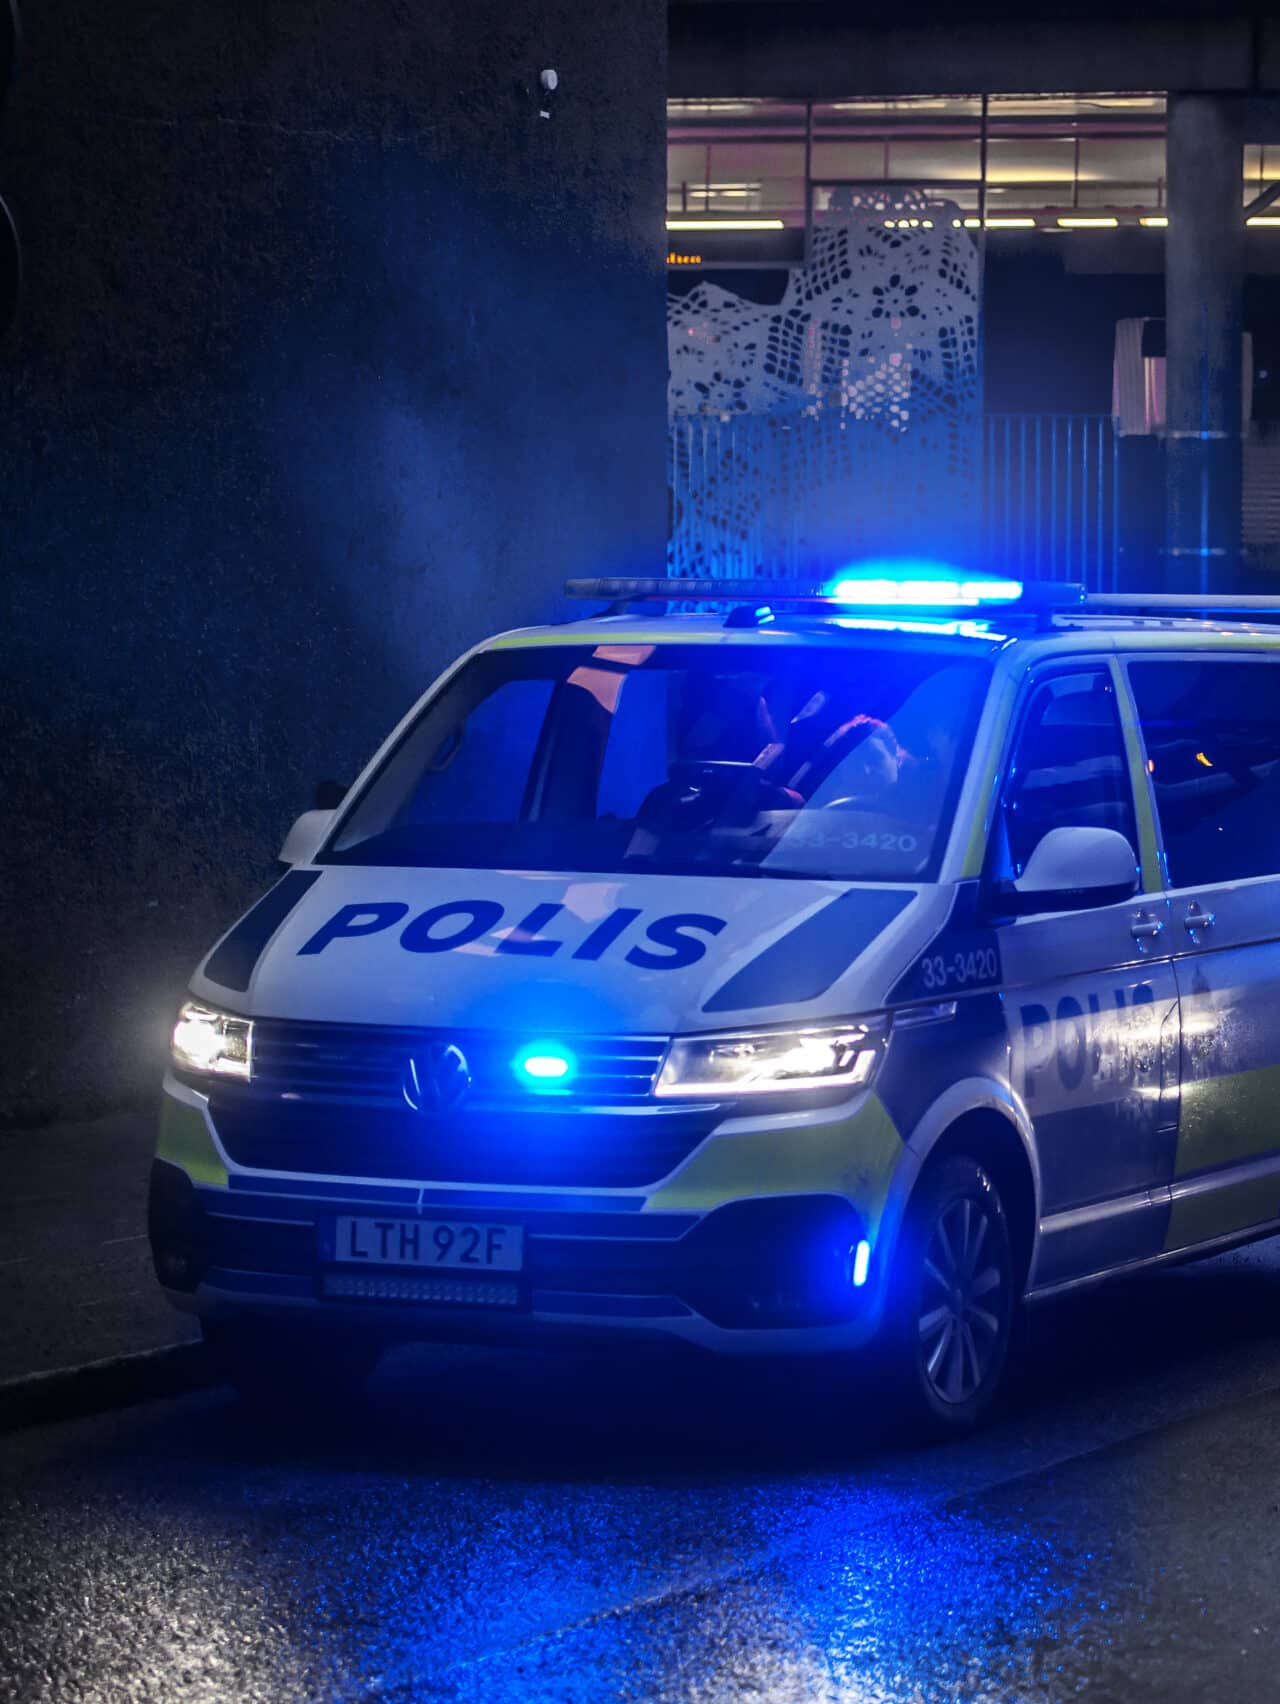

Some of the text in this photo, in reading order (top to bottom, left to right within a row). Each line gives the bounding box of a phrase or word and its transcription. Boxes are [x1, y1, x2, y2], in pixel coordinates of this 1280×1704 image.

[296, 899, 728, 970] POLIS
[921, 947, 998, 989] 33-3420
[350, 1220, 505, 1265] LTH 92F
